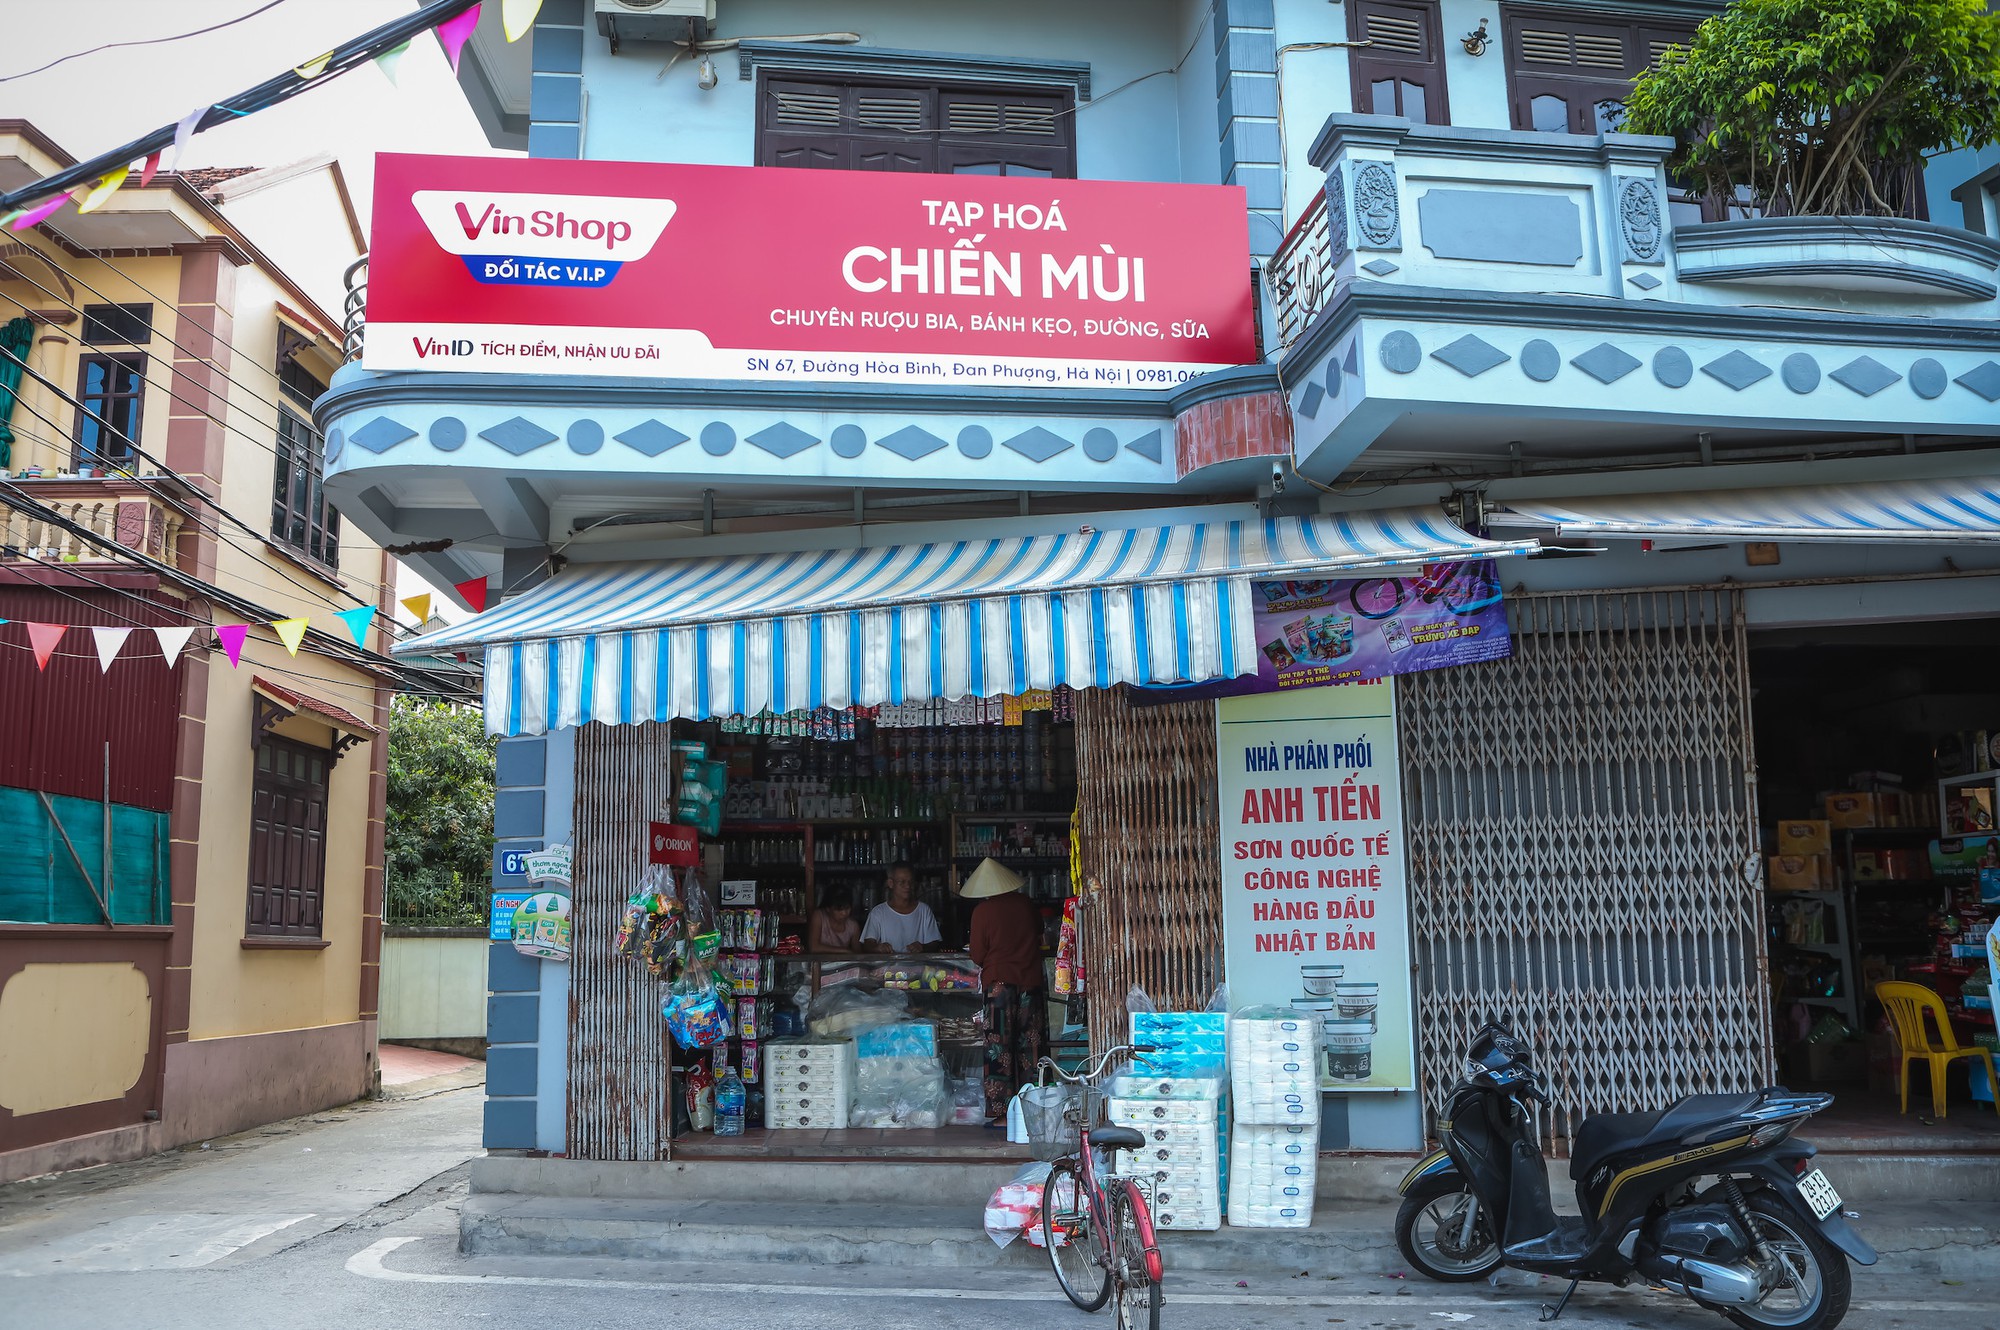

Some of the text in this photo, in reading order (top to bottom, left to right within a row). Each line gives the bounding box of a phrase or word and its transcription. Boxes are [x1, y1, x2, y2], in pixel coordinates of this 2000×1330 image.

[454, 202, 631, 250] VinShop
[922, 199, 1067, 233] TẠP HOÁ
[484, 258, 606, 282] ĐỐI TÁC V.I.P
[841, 233, 1145, 302] CHIẾN MÙI
[769, 306, 1210, 339] CHUYÊN RƯỢU BIA, BÁNH KẸO, ĐƯỜNG, SỮA
[412, 336, 660, 361] VinID TÍCH ĐIỂM, NHẬN ƯU ĐÃI
[746, 357, 769, 371] SN
[775, 358, 796, 374] 67,
[802, 359, 859, 376] Đường
[866, 360, 899, 374] Hòa
[952, 363, 987, 376] Đan
[993, 364, 1061, 382] Phượng,
[1067, 367, 1089, 380] Hà
[1095, 367, 1121, 384] Nội
[1447, 629, 1461, 638] XE
[1461, 626, 1481, 637] ĐẠP
[1307, 668, 1312, 676] 6
[1245, 733, 1372, 772] NHÀ PHÂN PHỐI
[1241, 771, 1381, 824] ANH TIẾN
[665, 839, 692, 852] ORION
[1233, 829, 1391, 860] SƠN QUỐC TẾ
[1244, 864, 1382, 891] CÔNG NGHỆ
[1253, 894, 1375, 921] HÀNG ĐẦU
[1255, 923, 1376, 956] NHẬT BẢN
